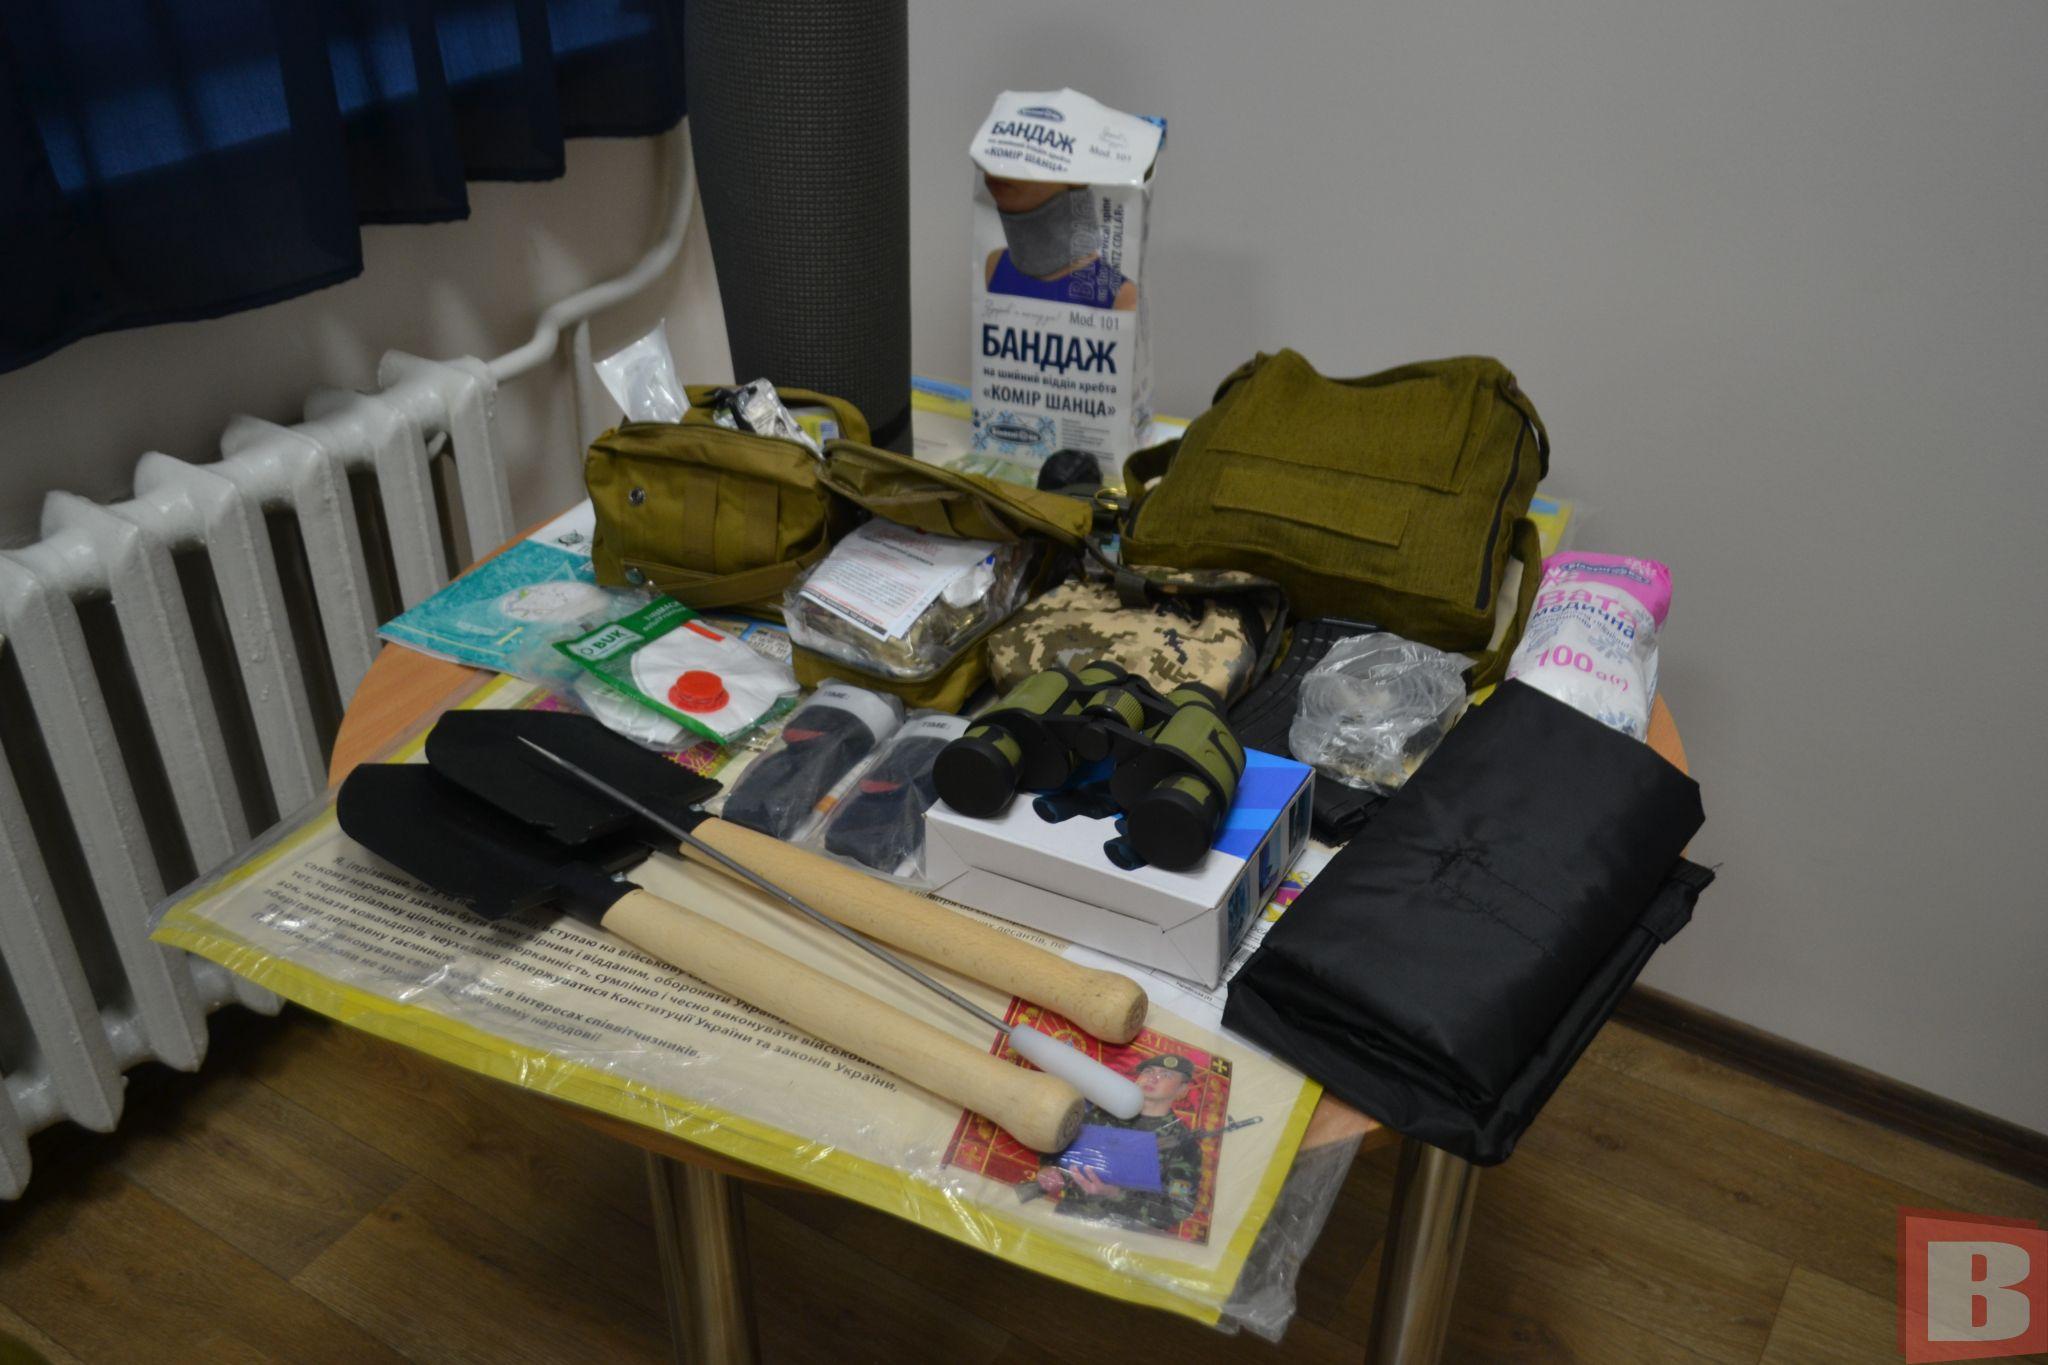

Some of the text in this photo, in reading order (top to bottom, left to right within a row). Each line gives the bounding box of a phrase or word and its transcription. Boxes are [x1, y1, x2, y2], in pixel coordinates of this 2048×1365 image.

[991, 121, 1076, 154] БАНДАЖ
[1069, 311, 1096, 328] Mod.
[1101, 316, 1120, 331] 101
[982, 323, 1117, 374] БАНДАЖ
[983, 367, 1117, 394] на шийний відділ хребта
[983, 384, 1116, 419] «КОМІР ШАНЦА»
[1536, 644, 1593, 673] 100
[304, 862, 350, 881] ському
[349, 878, 408, 901] народові
[408, 897, 456, 916] завжди
[457, 910, 489, 927] бути
[526, 934, 574, 956] вірним
[582, 953, 650, 982] відданим,
[653, 975, 731, 1004] обороняти
[599, 943, 616, 954] на
[315, 879, 406, 916] територіальну
[405, 910, 468, 937] цілісність
[594, 973, 660, 997] сумлінно
[670, 995, 710, 1013] чесно
[711, 1008, 799, 1042] виконувати
[304, 890, 349, 910] накази
[349, 907, 427, 939] командирів,
[500, 956, 609, 998] додержуватися
[609, 991, 696, 1024] Конституції
[694, 1016, 753, 1044] України
[755, 1037, 771, 1050] та
[773, 1043, 832, 1069] законів
[834, 1061, 898, 1093] України,
[516, 991, 585, 1021] інтересах
